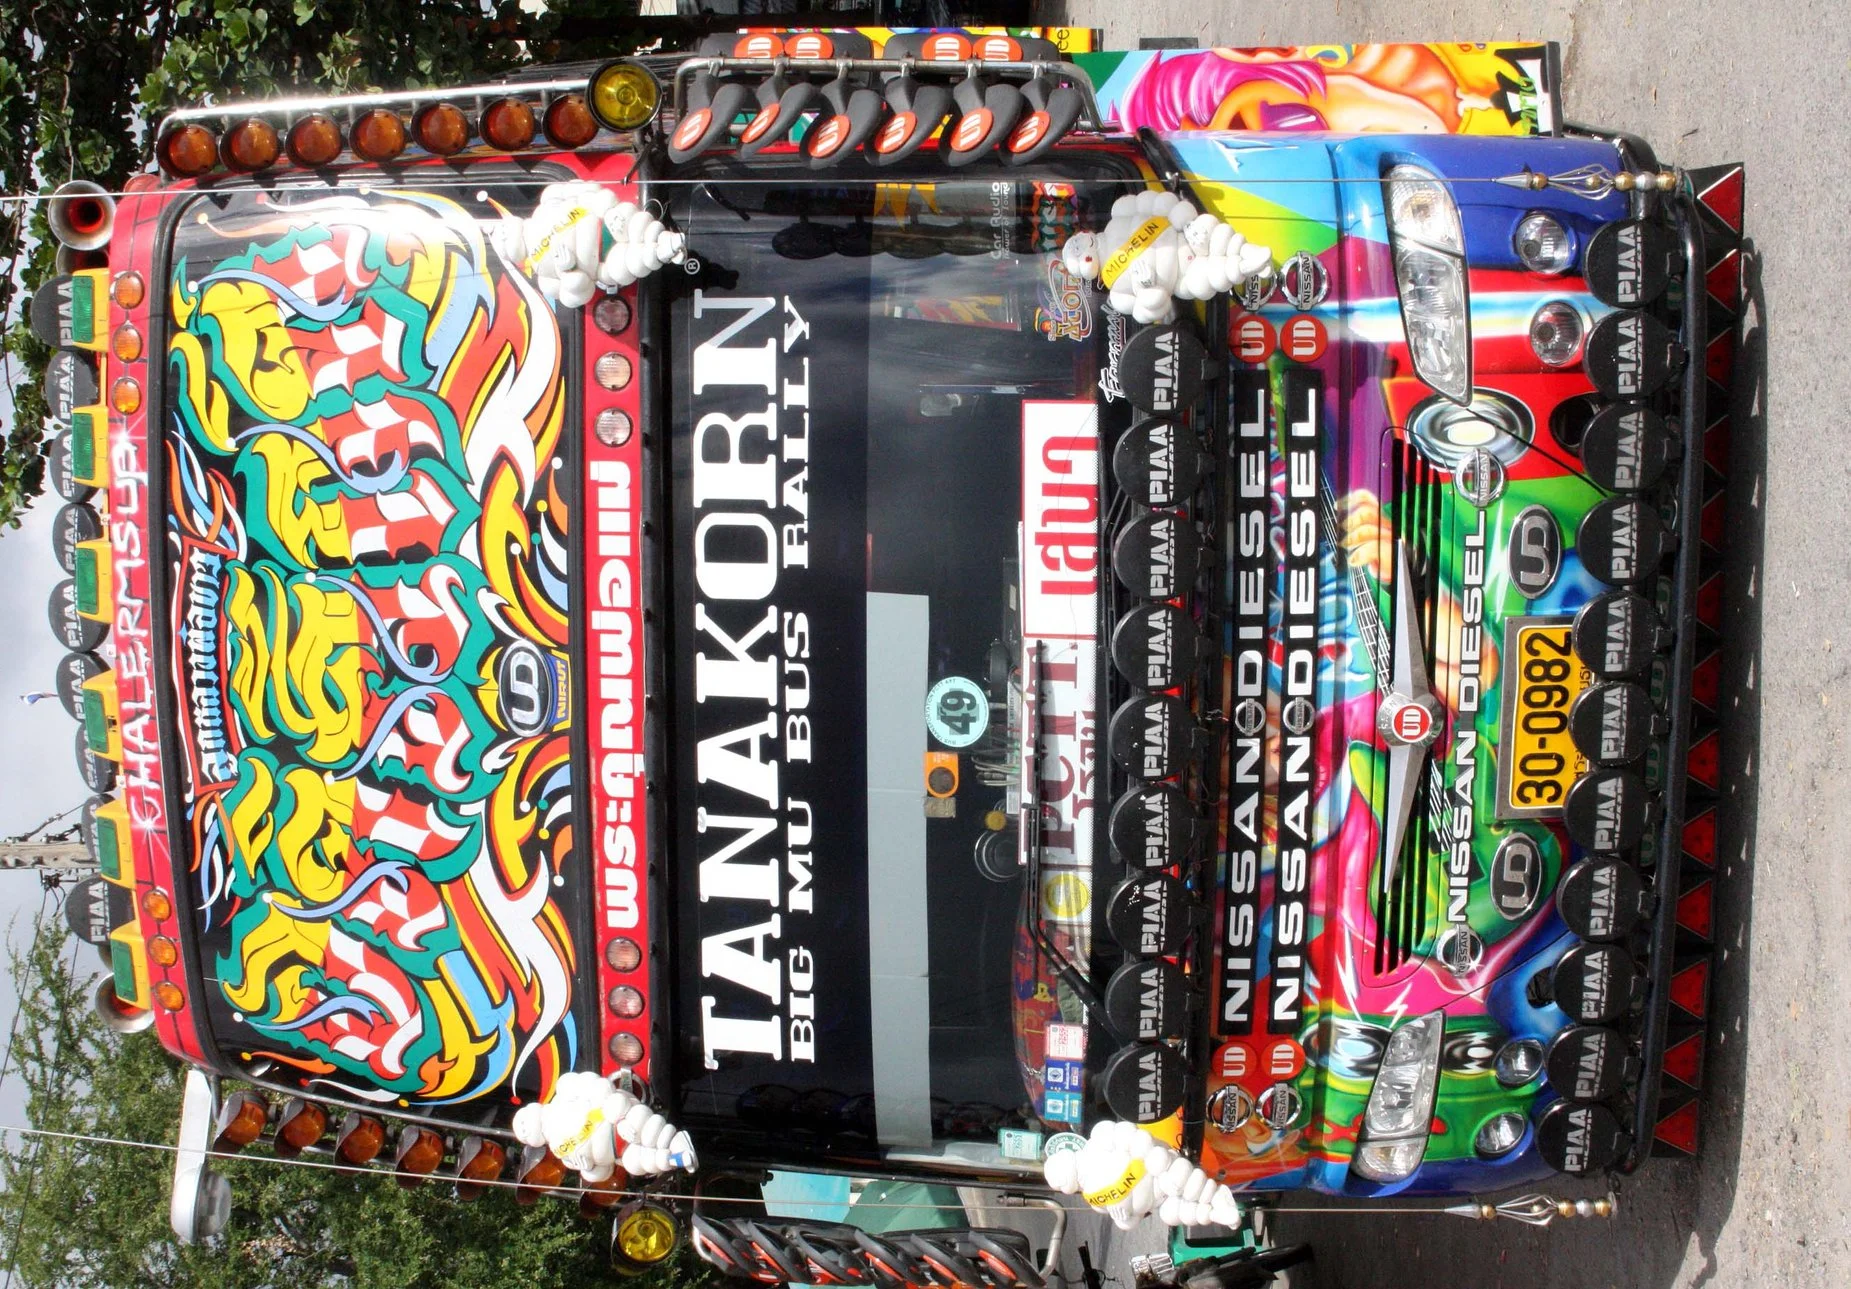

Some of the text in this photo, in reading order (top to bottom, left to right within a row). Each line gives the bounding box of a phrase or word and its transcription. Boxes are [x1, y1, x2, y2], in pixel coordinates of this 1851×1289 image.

[959, 113, 981, 148] UD
[989, 182, 1001, 260] Car Audio
[1105, 221, 1159, 278] MICHELIN
[1251, 274, 1259, 304] NISS
[1303, 256, 1311, 303] NISSAN
[1618, 225, 1637, 302] PIAA
[57, 280, 73, 346] PIAA
[1240, 320, 1265, 359] UD
[1292, 319, 1316, 359] UD
[59, 355, 72, 419] PIAA
[1153, 330, 1174, 411] PIAA
[1618, 317, 1637, 394] PIAA
[62, 433, 73, 497] PIAA
[1149, 423, 1169, 503] PIAA
[1479, 454, 1489, 501] NISSAN
[1614, 412, 1638, 488] PIAA
[64, 507, 76, 570] PIAA
[1034, 436, 1099, 595] เสนา
[1519, 513, 1550, 586] UD
[1612, 503, 1632, 579] PIAA
[1150, 518, 1169, 596] PIAA
[63, 584, 81, 647] PIAA
[1147, 609, 1167, 687] PIAA
[1604, 599, 1627, 672] PIAA
[69, 658, 86, 720] PIAA
[509, 651, 539, 726] UD
[556, 659, 568, 718] NIRUT
[590, 460, 645, 929] พระคุณพ่อแม่
[692, 288, 782, 1070] TANAKORN
[783, 294, 815, 1063] BIG MU BUS RALLY
[940, 690, 977, 735] 49
[1224, 388, 1265, 1022] NISSAN DIESEL
[1273, 388, 1316, 1021] NISSAN DIESEL
[1143, 701, 1163, 777] PIAA
[1401, 708, 1421, 737] UD
[1447, 510, 1486, 922] NISSAN DIESEL
[1515, 631, 1572, 804] 30-0982
[1600, 686, 1626, 759] PIAA
[1145, 792, 1164, 867] PIAA
[1594, 778, 1615, 850] PIAA
[1501, 842, 1533, 909] UD
[1588, 865, 1612, 936] PIAA
[88, 880, 106, 943] PIAA
[1141, 879, 1164, 953] PIAA
[1458, 931, 1468, 973] NISSAN
[1581, 950, 1603, 1019] PIAA
[1139, 967, 1159, 1038] PIAA
[1138, 1051, 1156, 1121] PIAA
[1223, 1046, 1246, 1077] UD
[1271, 1044, 1295, 1075] UD
[1574, 1033, 1599, 1097] PIAA
[1227, 1092, 1236, 1131] NISSAN
[1564, 1108, 1587, 1172] PIAA
